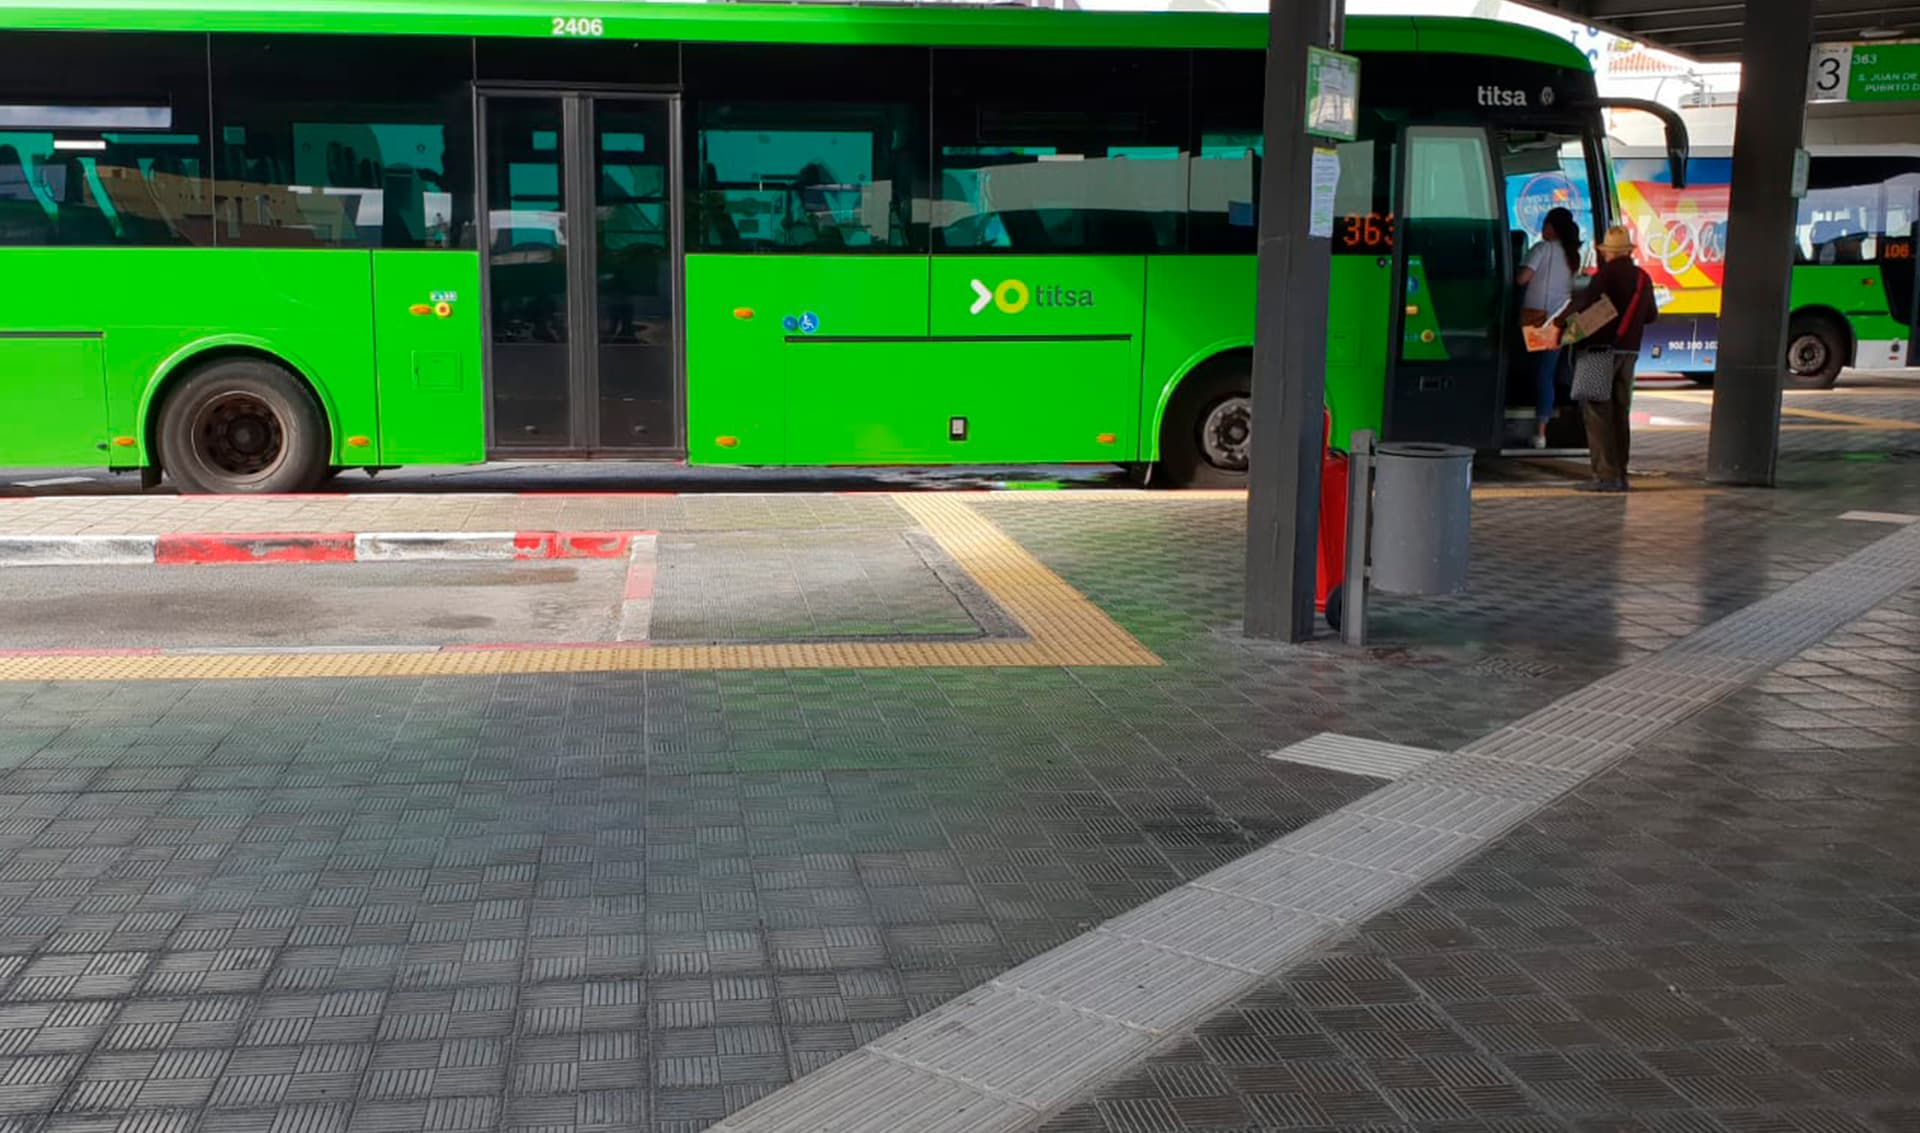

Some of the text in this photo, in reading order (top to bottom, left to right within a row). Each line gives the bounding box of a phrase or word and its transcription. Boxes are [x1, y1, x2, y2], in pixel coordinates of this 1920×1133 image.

[552, 17, 604, 36] 2406
[1852, 54, 1878, 65] 363
[1816, 57, 1841, 91] 3
[1870, 72, 1900, 82] JUAN
[1902, 72, 1918, 81] DE
[1477, 86, 1527, 106] titsa
[1865, 83, 1910, 93] PUERTO
[1343, 213, 1394, 246] 363
[1884, 243, 1910, 258] 106
[1036, 285, 1093, 307] titsa
